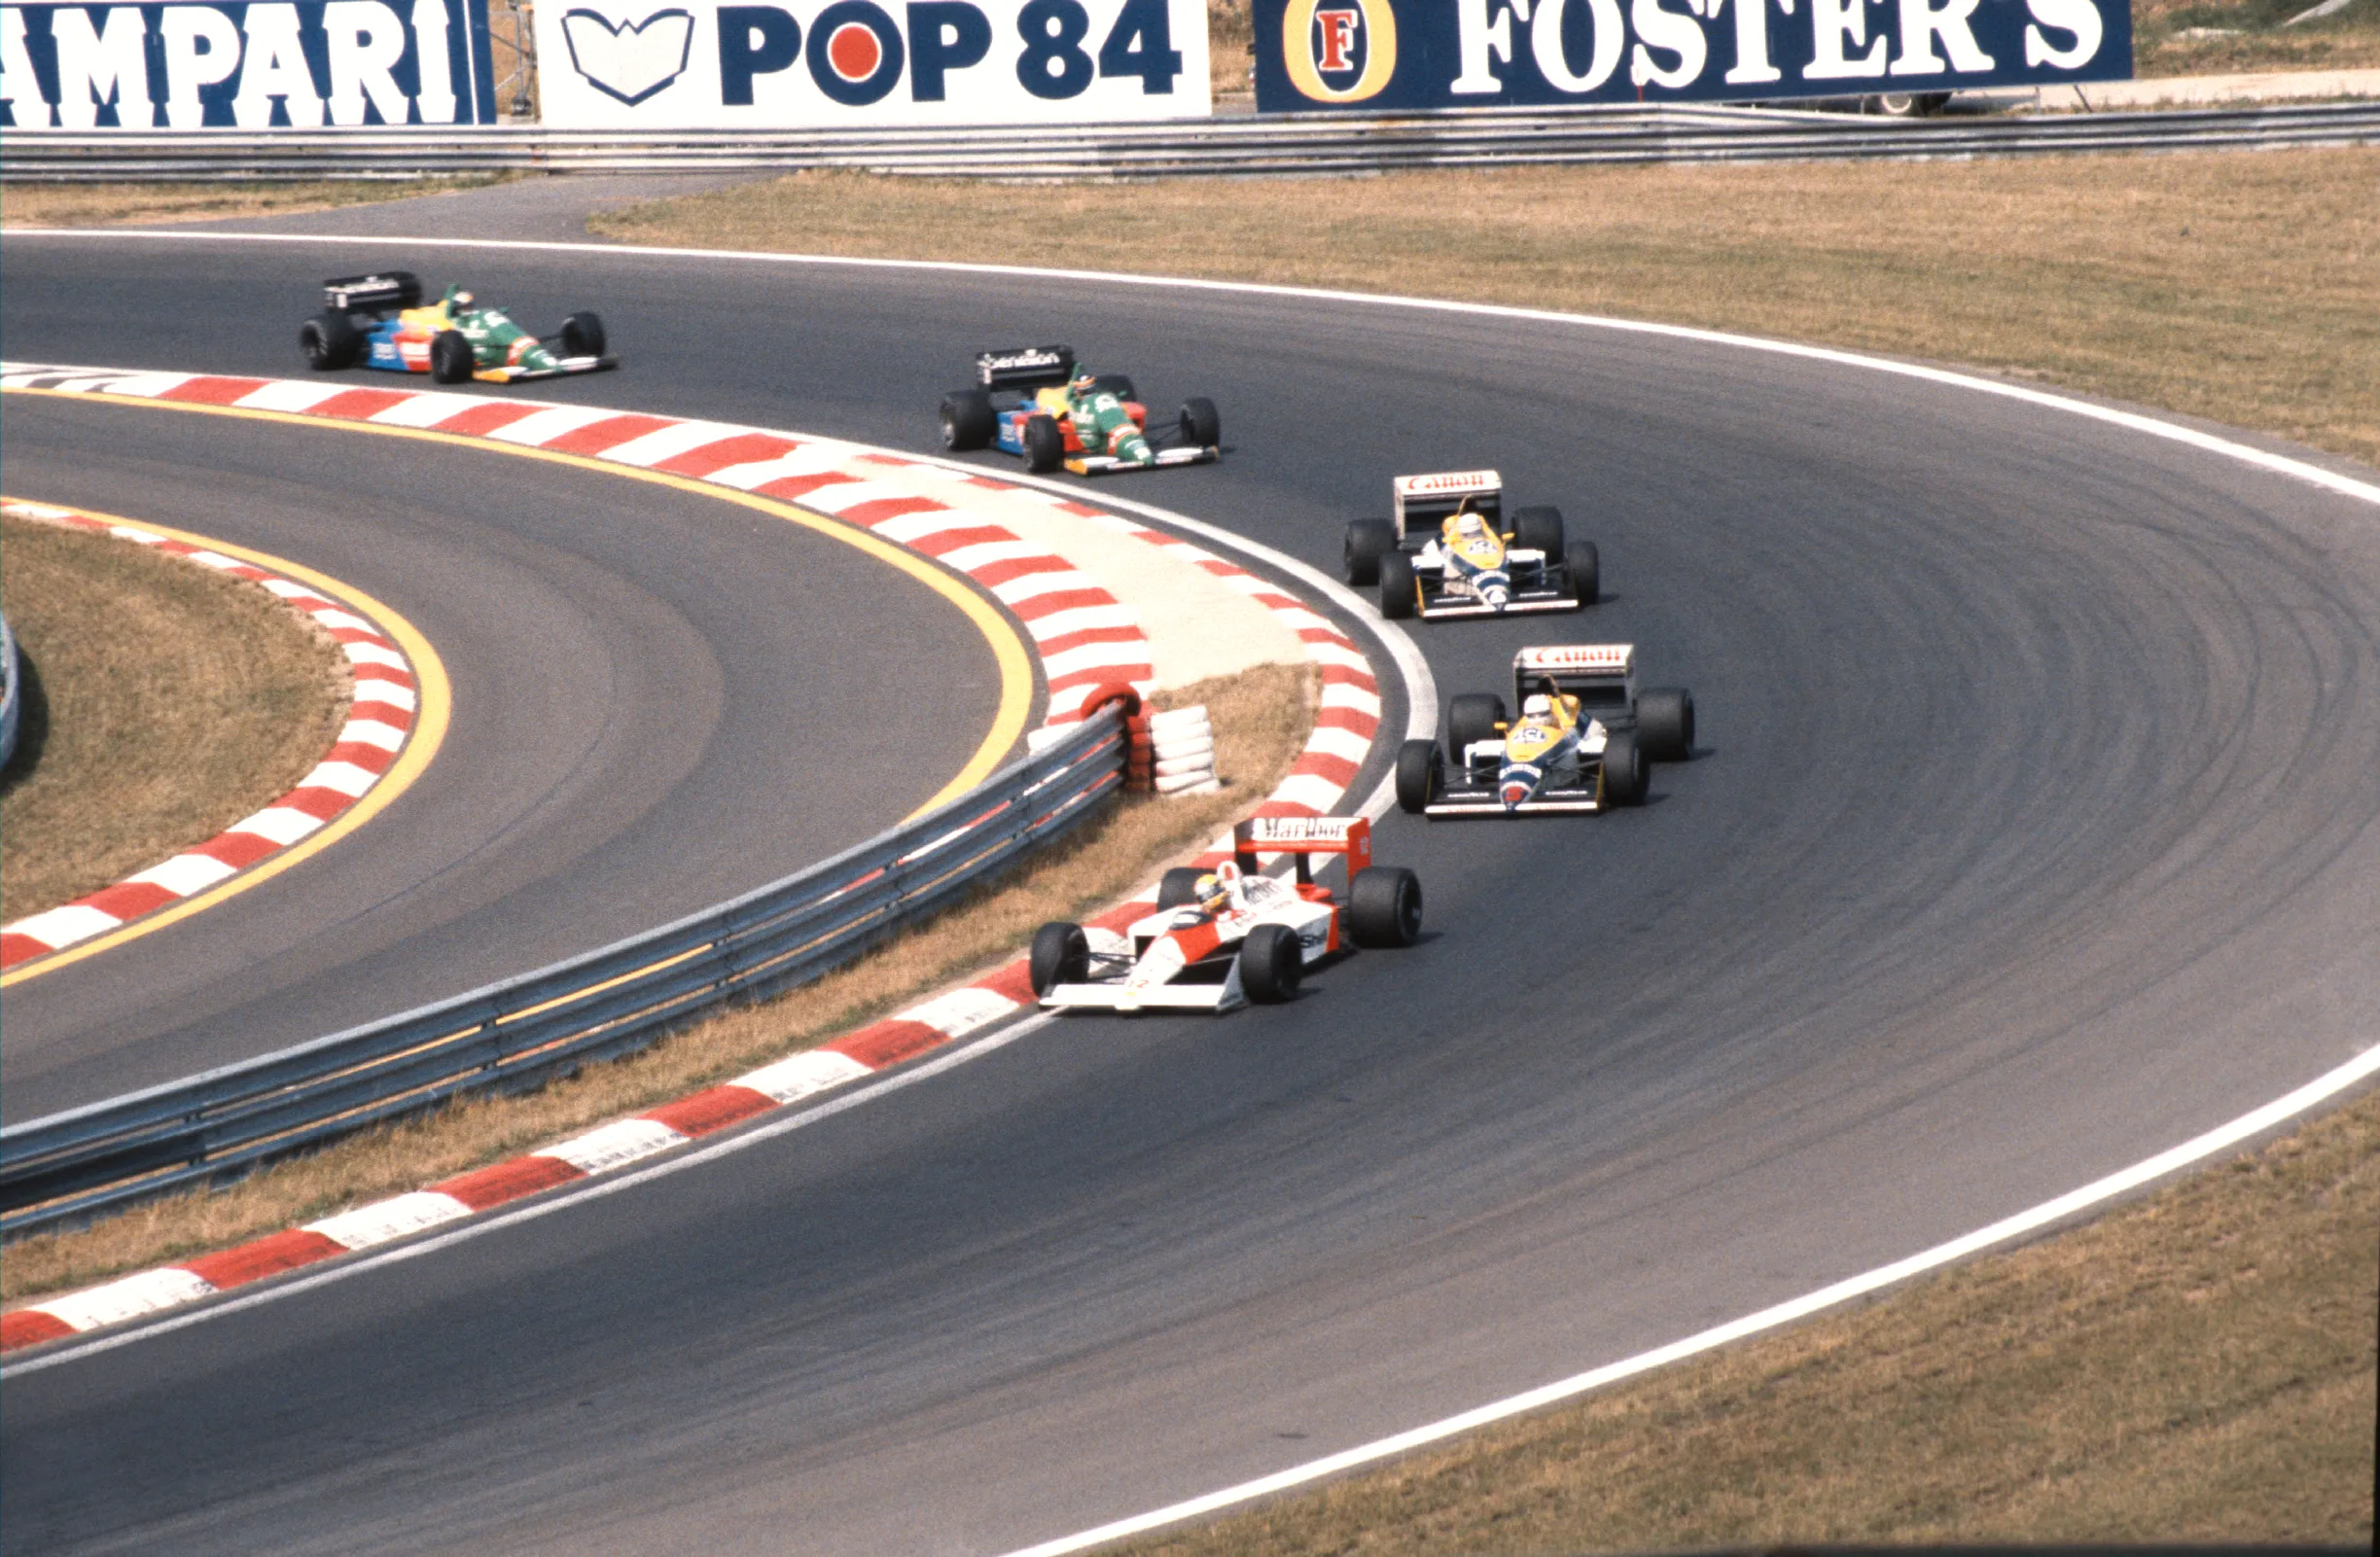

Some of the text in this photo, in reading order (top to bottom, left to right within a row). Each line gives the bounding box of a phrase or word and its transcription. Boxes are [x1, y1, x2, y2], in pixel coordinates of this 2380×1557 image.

[717, 0, 1184, 106] POP 84
[1316, 9, 1358, 71] F
[1450, 0, 2103, 92] FOSTERS
[1264, 817, 1346, 837] Marlbor
